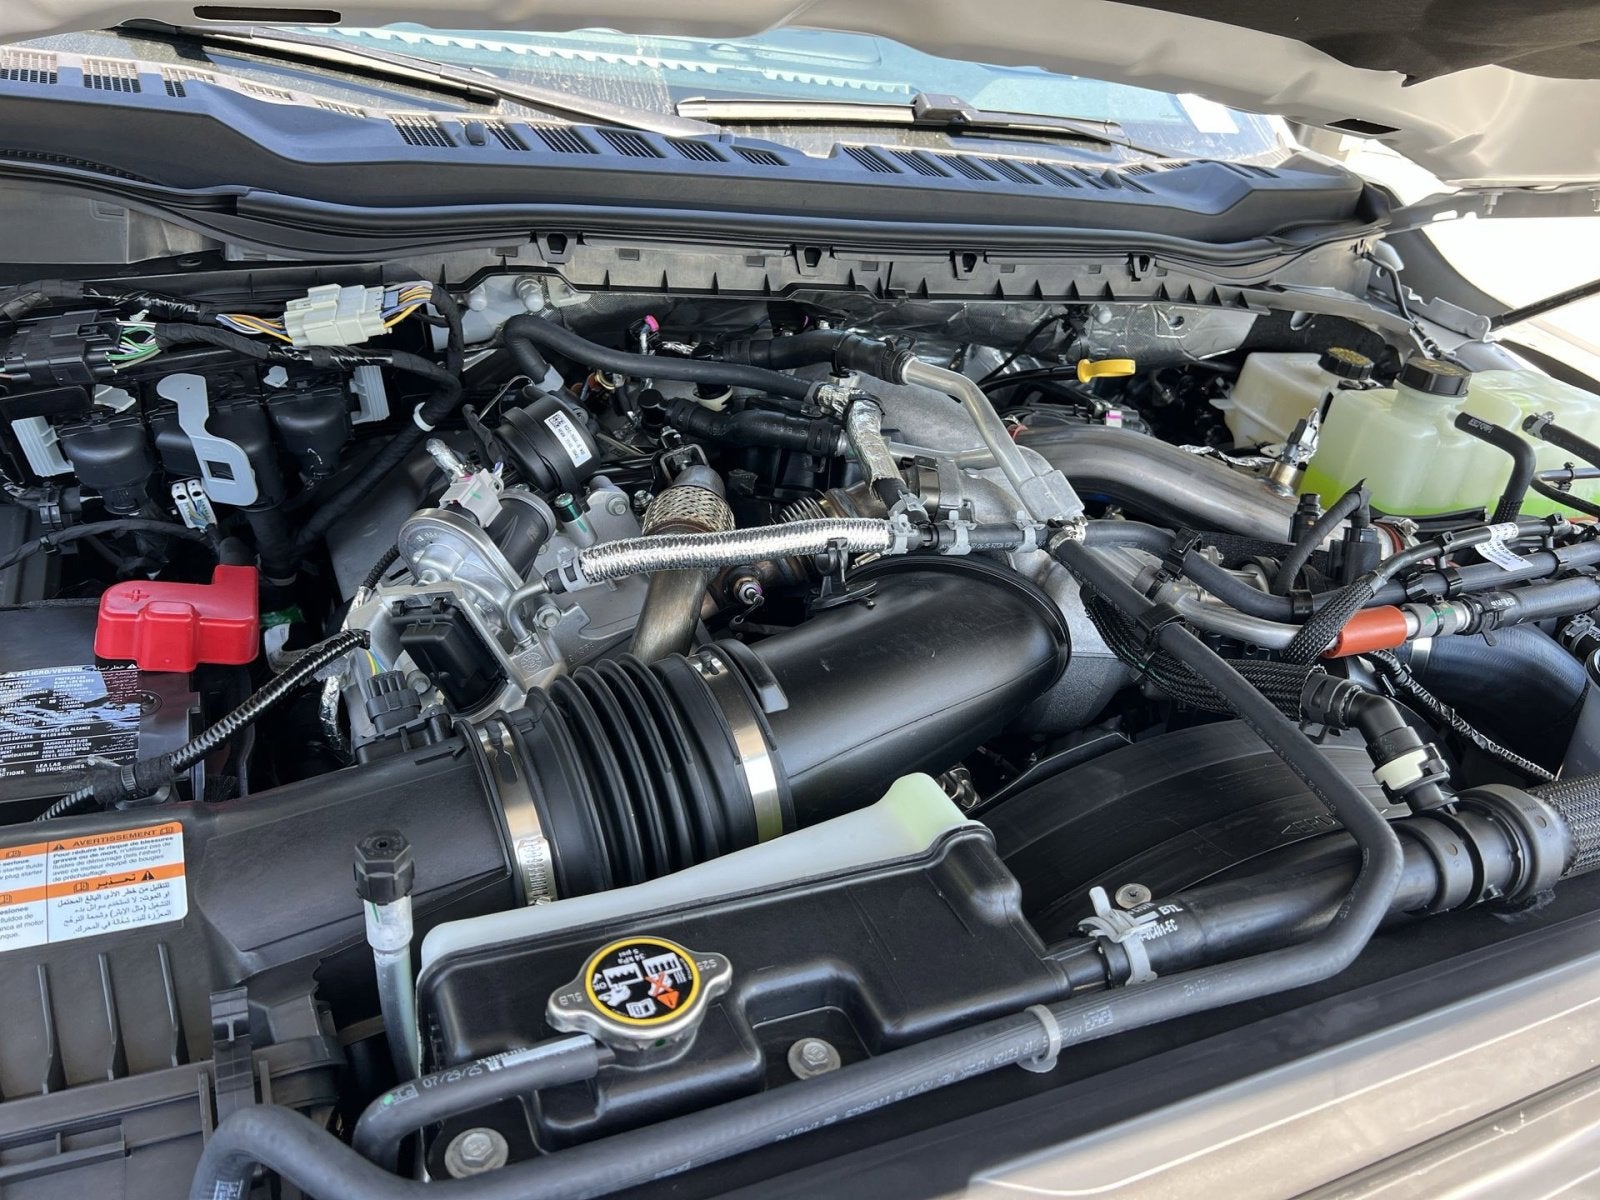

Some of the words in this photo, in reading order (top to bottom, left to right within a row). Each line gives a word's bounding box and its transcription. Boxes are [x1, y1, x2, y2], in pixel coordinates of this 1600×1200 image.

[73, 830, 157, 847] AVERTISSEMENT
[71, 846, 97, 856] réduire
[106, 842, 129, 851] risque
[140, 836, 174, 845] blessures
[3, 859, 29, 867] serious
[52, 856, 78, 865] graves
[1157, 904, 1184, 915] BTL
[24, 919, 45, 928] motor
[592, 981, 608, 991] OK
[559, 992, 583, 1006] 5LB
